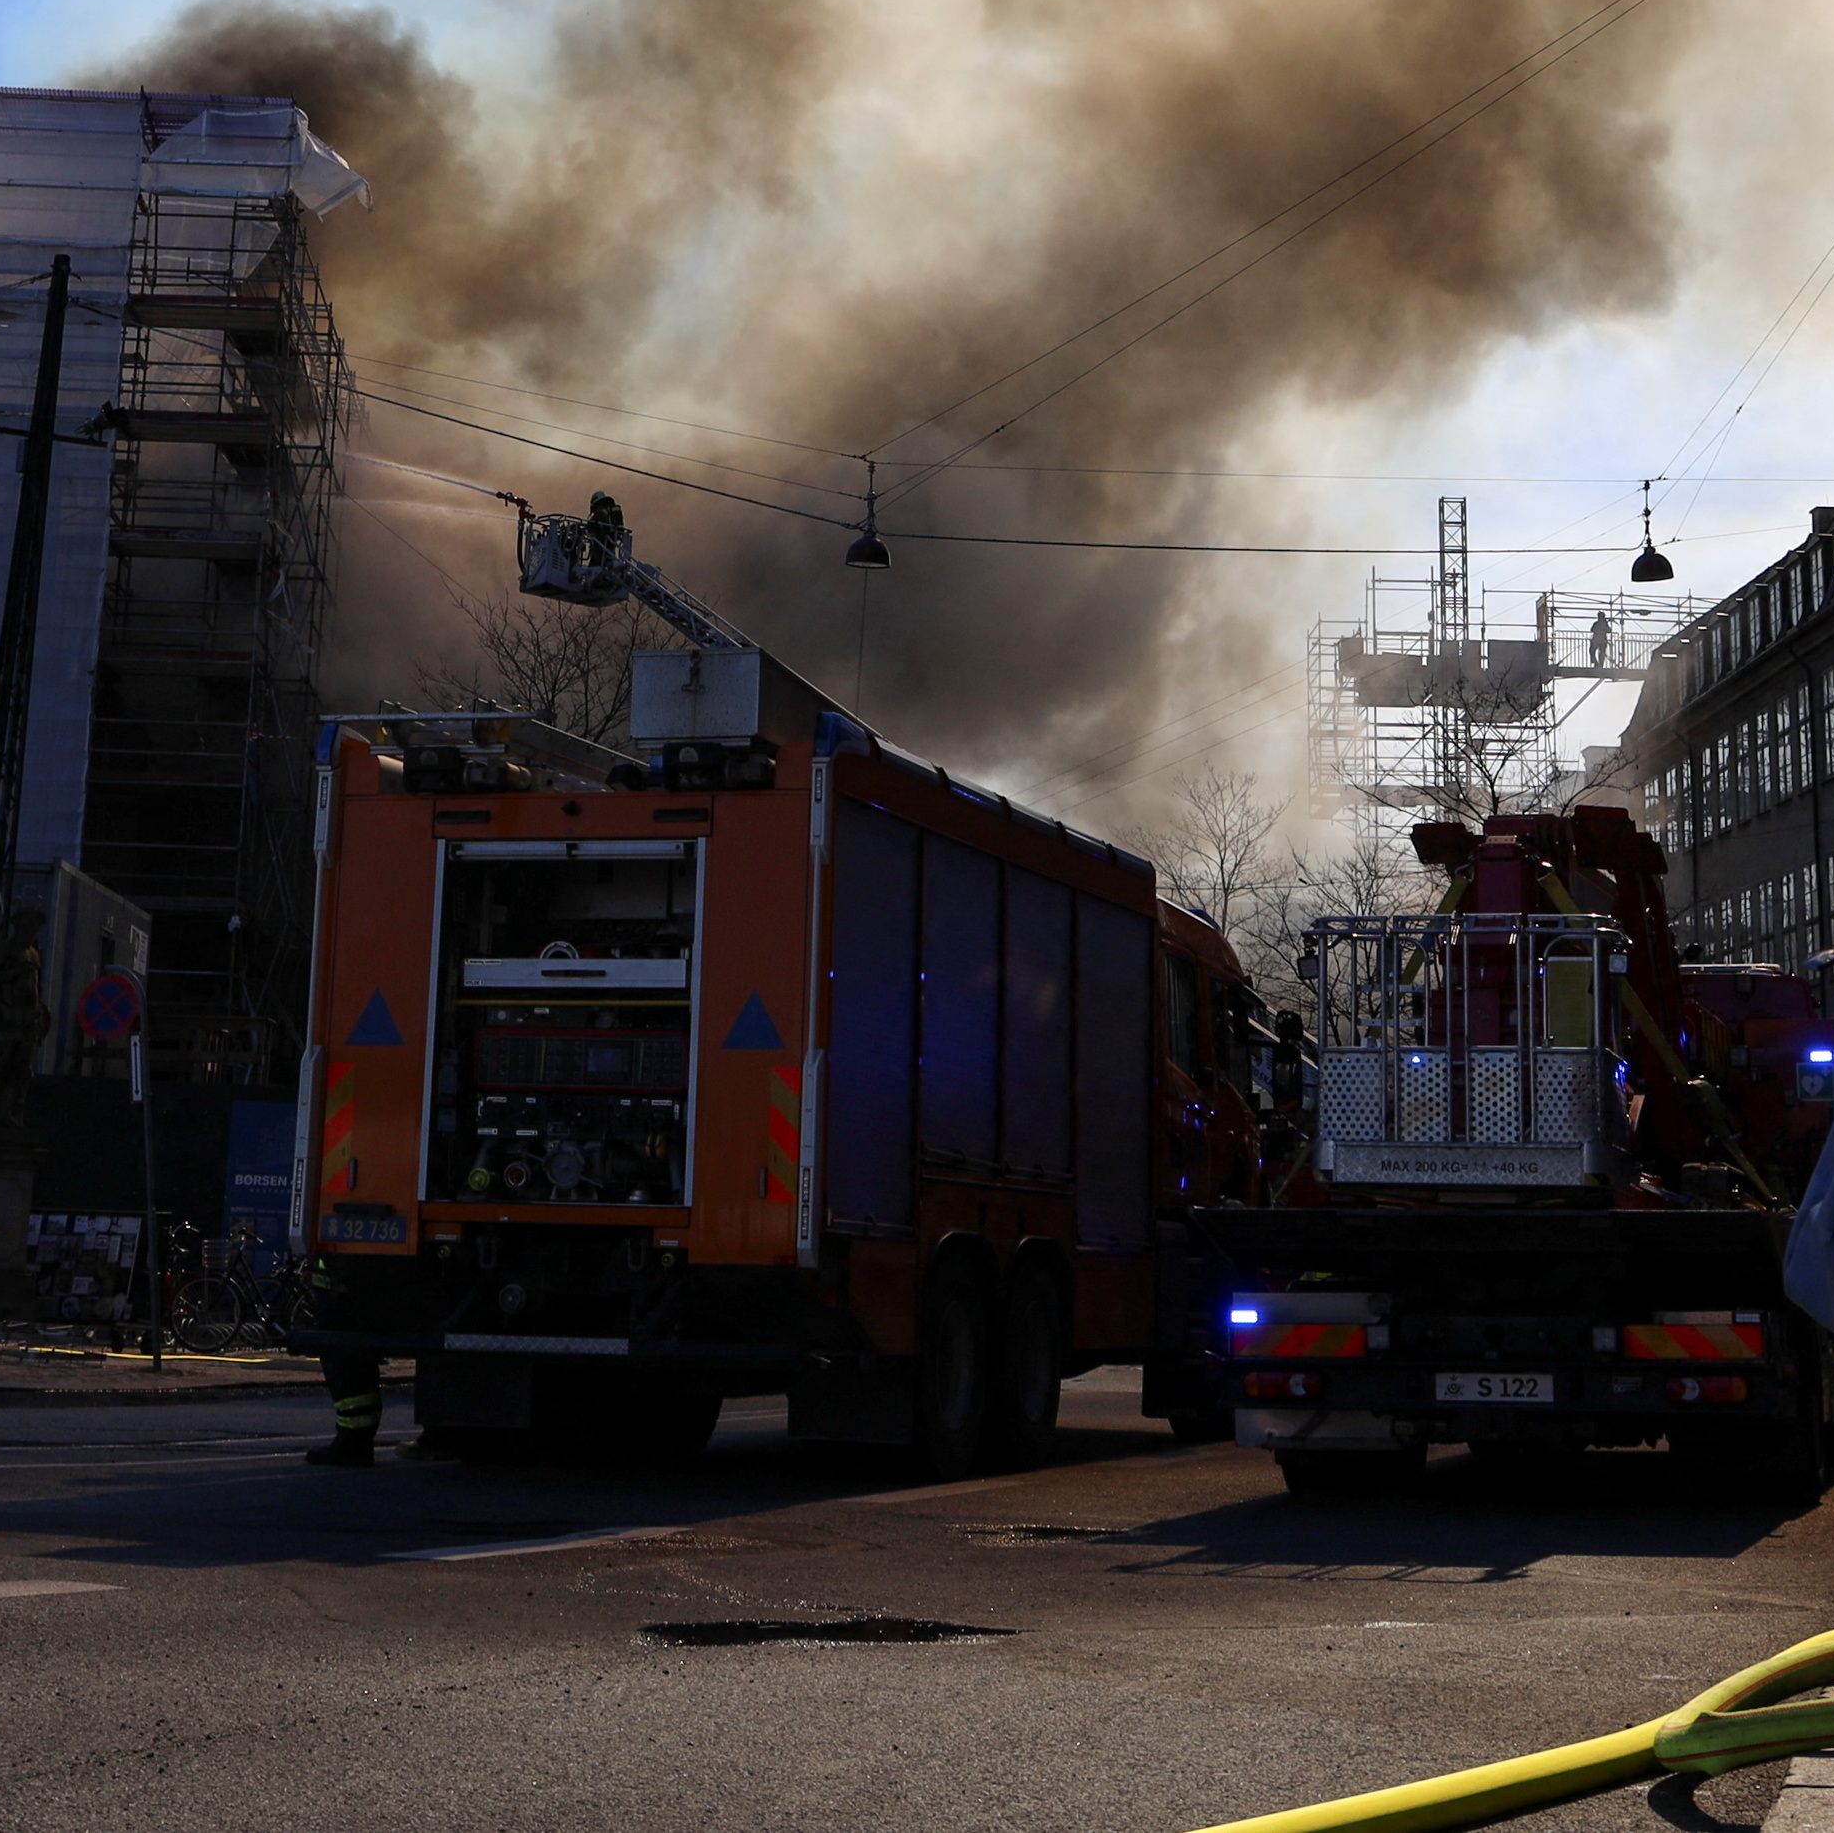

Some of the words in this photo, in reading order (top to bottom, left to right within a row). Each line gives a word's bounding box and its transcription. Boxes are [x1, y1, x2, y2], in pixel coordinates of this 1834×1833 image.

[1381, 1160, 1410, 1172] MAX
[1415, 1161, 1437, 1173] 200
[1519, 1162, 1538, 1174] KG
[234, 1174, 287, 1186] BØRSEN
[343, 1220, 364, 1239] 32
[369, 1220, 399, 1240] 736
[1477, 1377, 1493, 1397] S
[1499, 1378, 1538, 1397] 122
